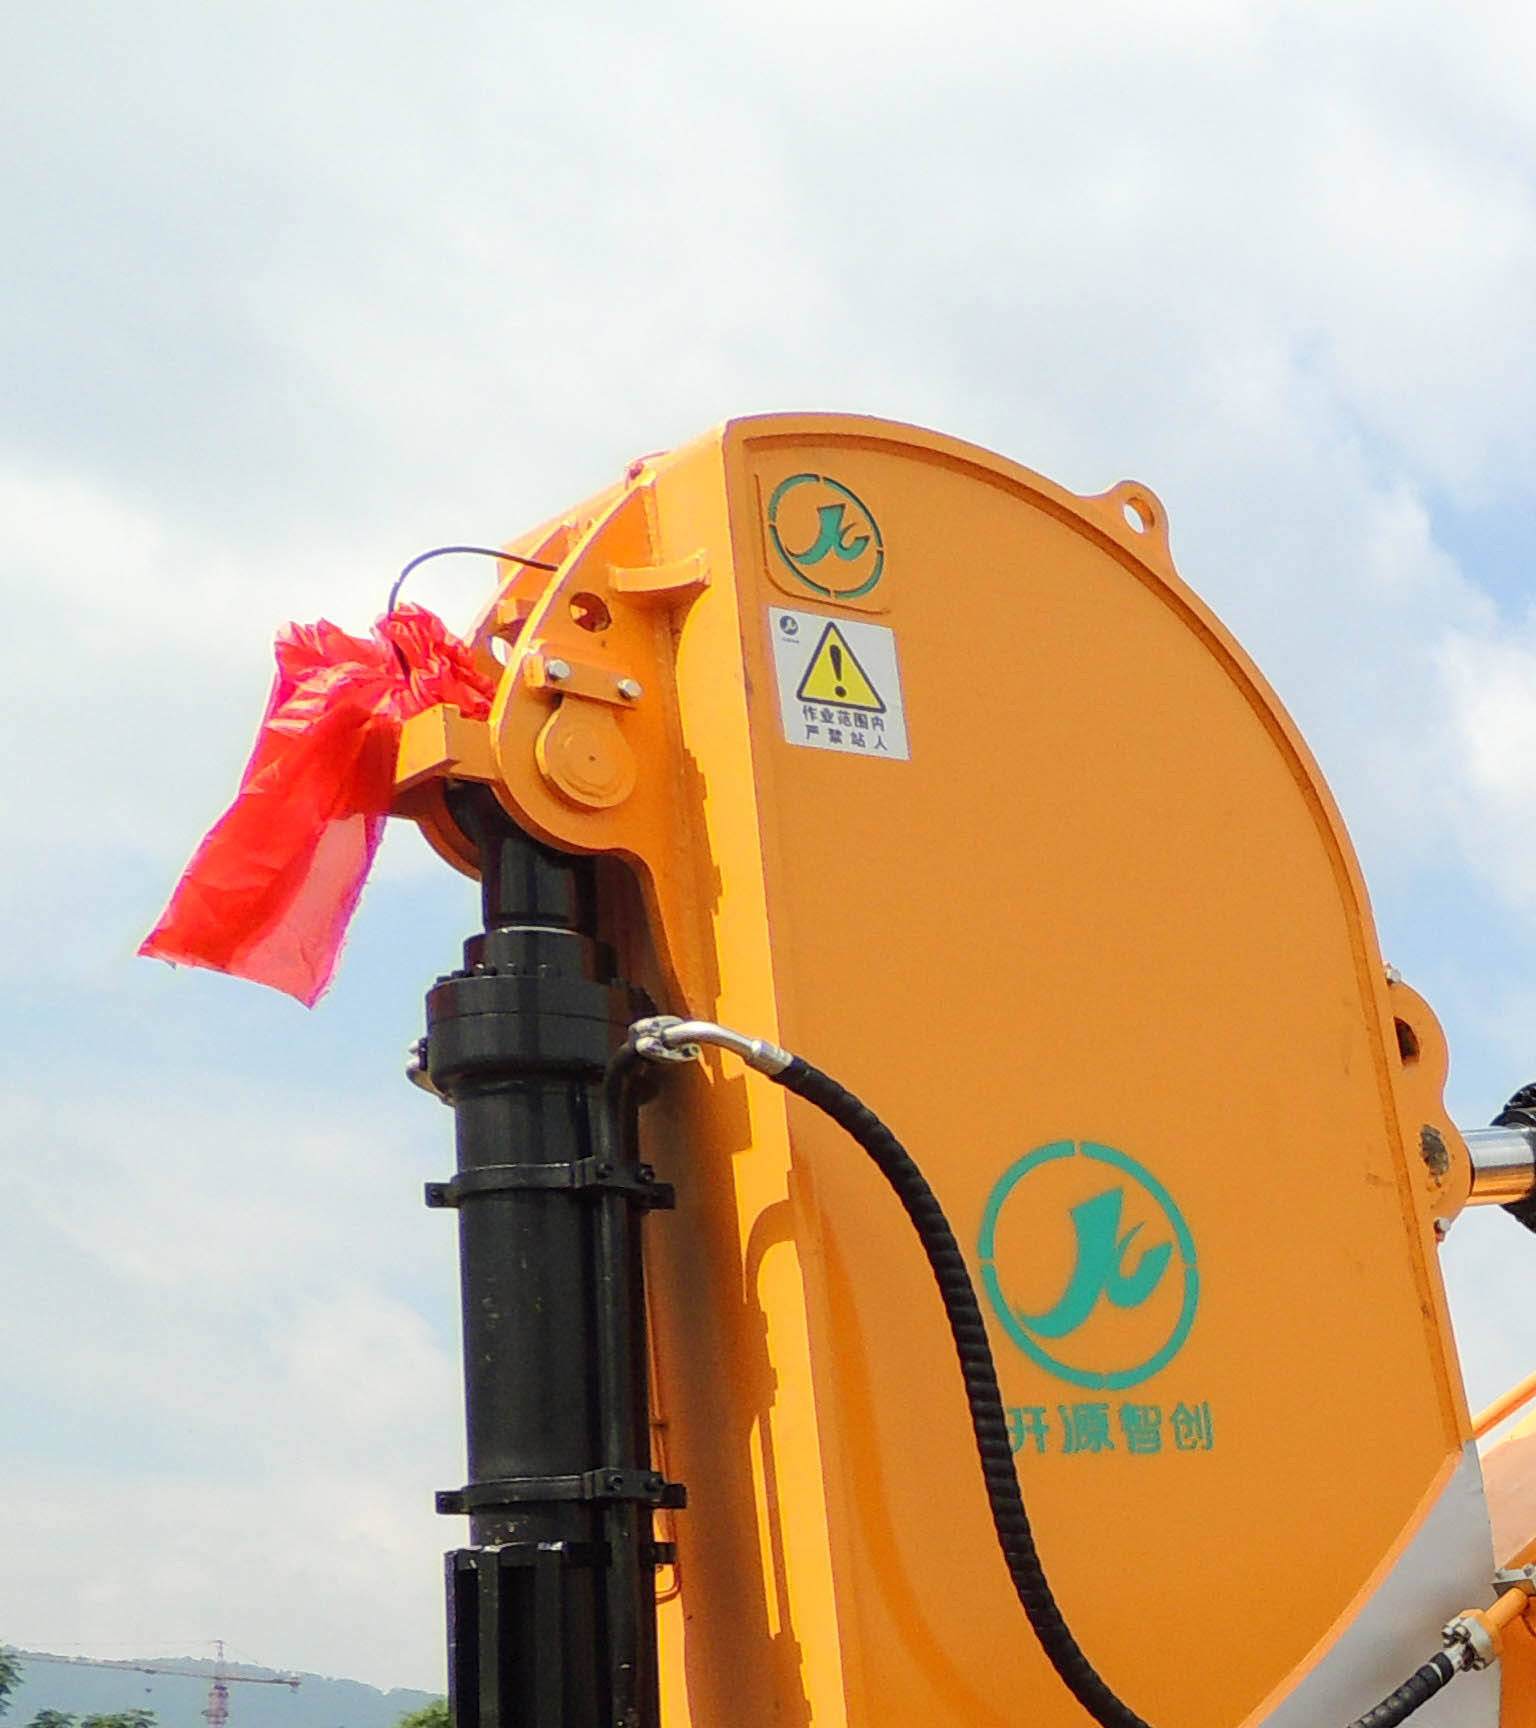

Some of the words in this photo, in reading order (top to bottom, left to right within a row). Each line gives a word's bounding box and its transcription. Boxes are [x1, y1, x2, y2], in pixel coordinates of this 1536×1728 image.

[802, 704, 885, 732] 作业范围内
[804, 724, 889, 751] 严禁站人
[1006, 1401, 1214, 1454] 开源智创
